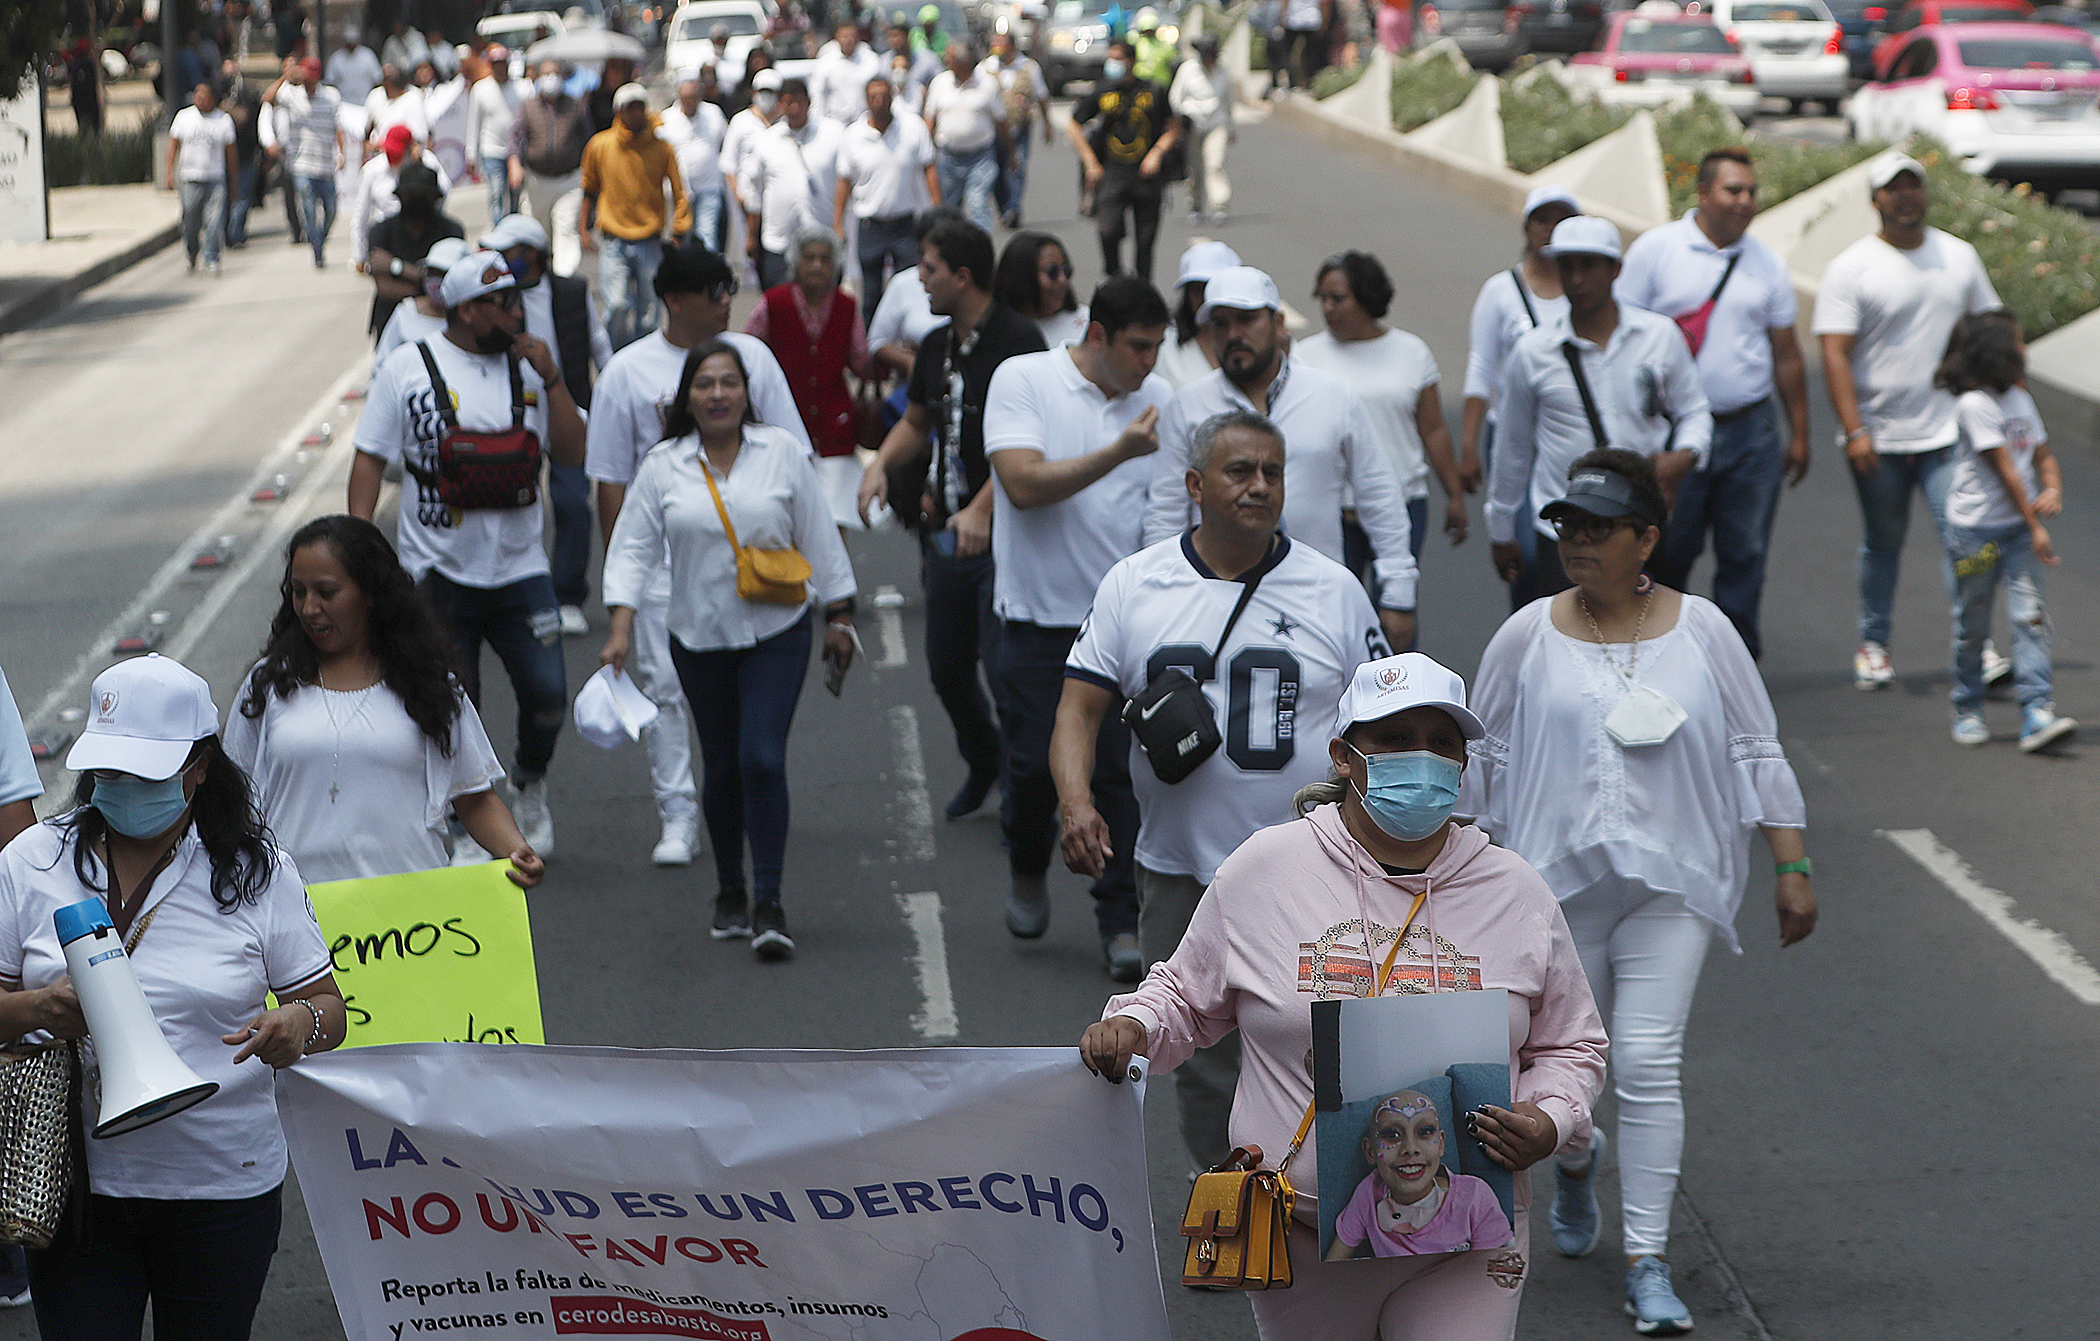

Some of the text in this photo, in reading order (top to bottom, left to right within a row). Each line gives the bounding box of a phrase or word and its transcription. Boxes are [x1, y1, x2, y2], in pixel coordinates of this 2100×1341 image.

[1279, 681, 1298, 708] EST.
[1376, 685, 1410, 700] ARTEMISAS
[1177, 730, 1200, 757] NIKE
[345, 1127, 429, 1171] LA
[610, 1191, 689, 1219] ES
[694, 1191, 797, 1223] UN
[804, 1171, 1125, 1253] DERECHO,
[361, 1191, 461, 1241] NO
[562, 1232, 769, 1269] FAVOR
[381, 1269, 889, 1319] Reporta la falta de medicamentos, insumos
[389, 1321, 404, 1341] y
[410, 1311, 508, 1332] vacunas
[514, 1310, 545, 1325] en
